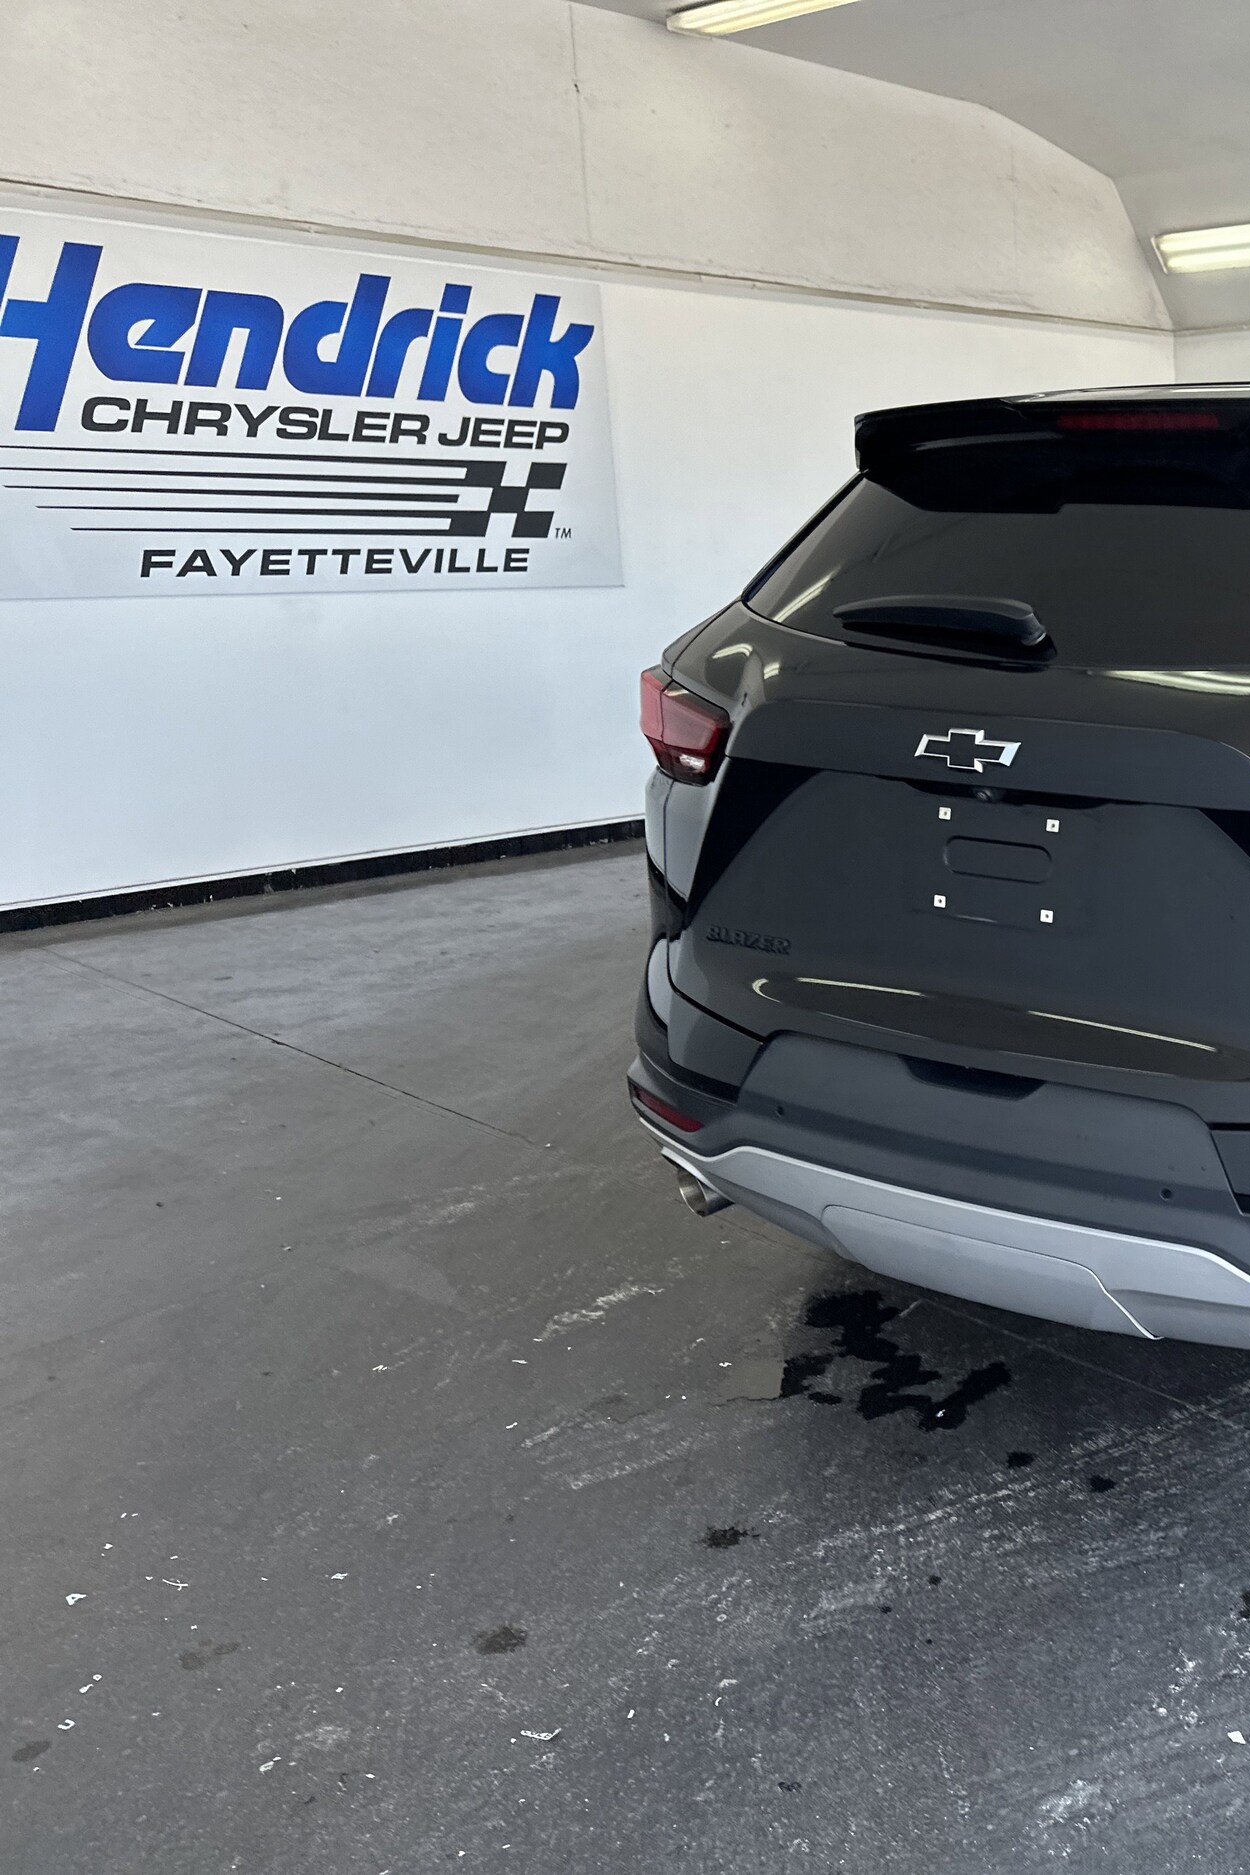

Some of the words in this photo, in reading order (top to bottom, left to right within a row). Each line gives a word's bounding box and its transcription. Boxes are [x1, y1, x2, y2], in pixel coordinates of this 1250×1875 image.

[0, 234, 595, 432] Hendrick
[80, 396, 431, 446] CHRYSLER
[438, 416, 570, 450] JEEP
[555, 527, 572, 539] TM
[139, 547, 530, 578] FAYETTEVILLE
[706, 925, 791, 955] BLAZER
